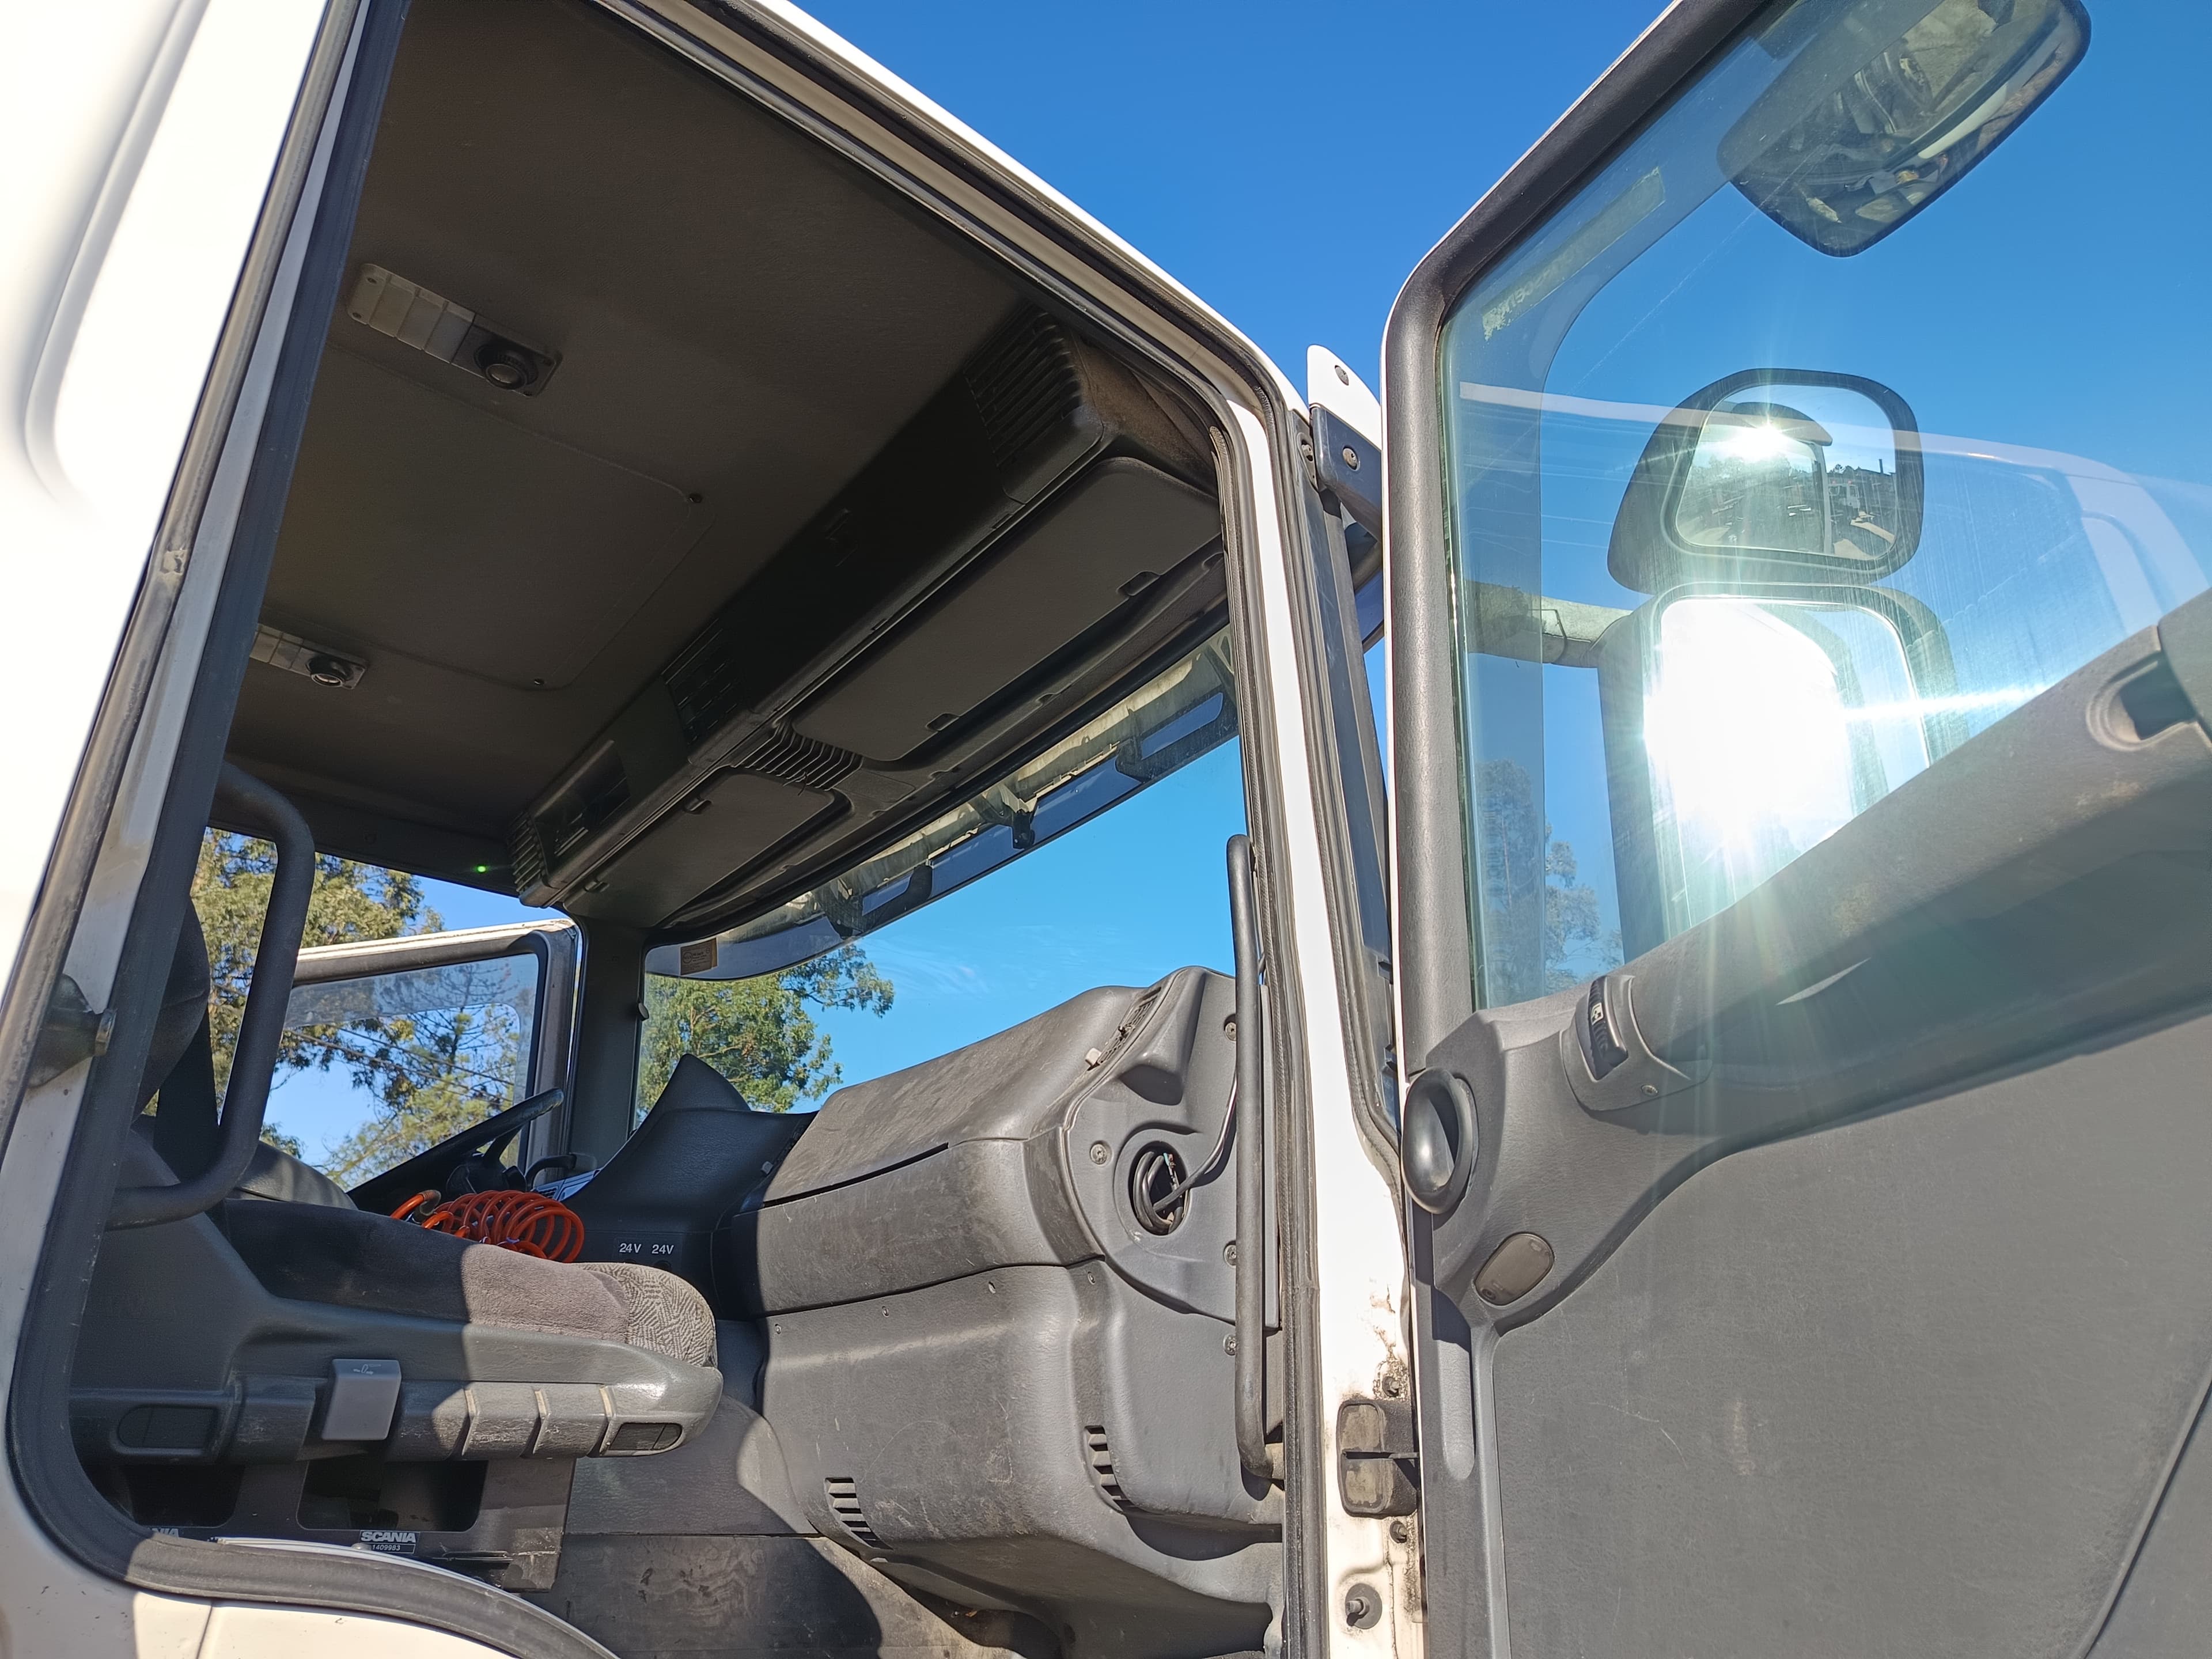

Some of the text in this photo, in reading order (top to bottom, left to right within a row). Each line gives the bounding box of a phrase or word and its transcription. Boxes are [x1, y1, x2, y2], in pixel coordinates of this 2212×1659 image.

[619, 1243, 674, 1254] 24V 24V
[361, 1532, 416, 1543] SCANIA
